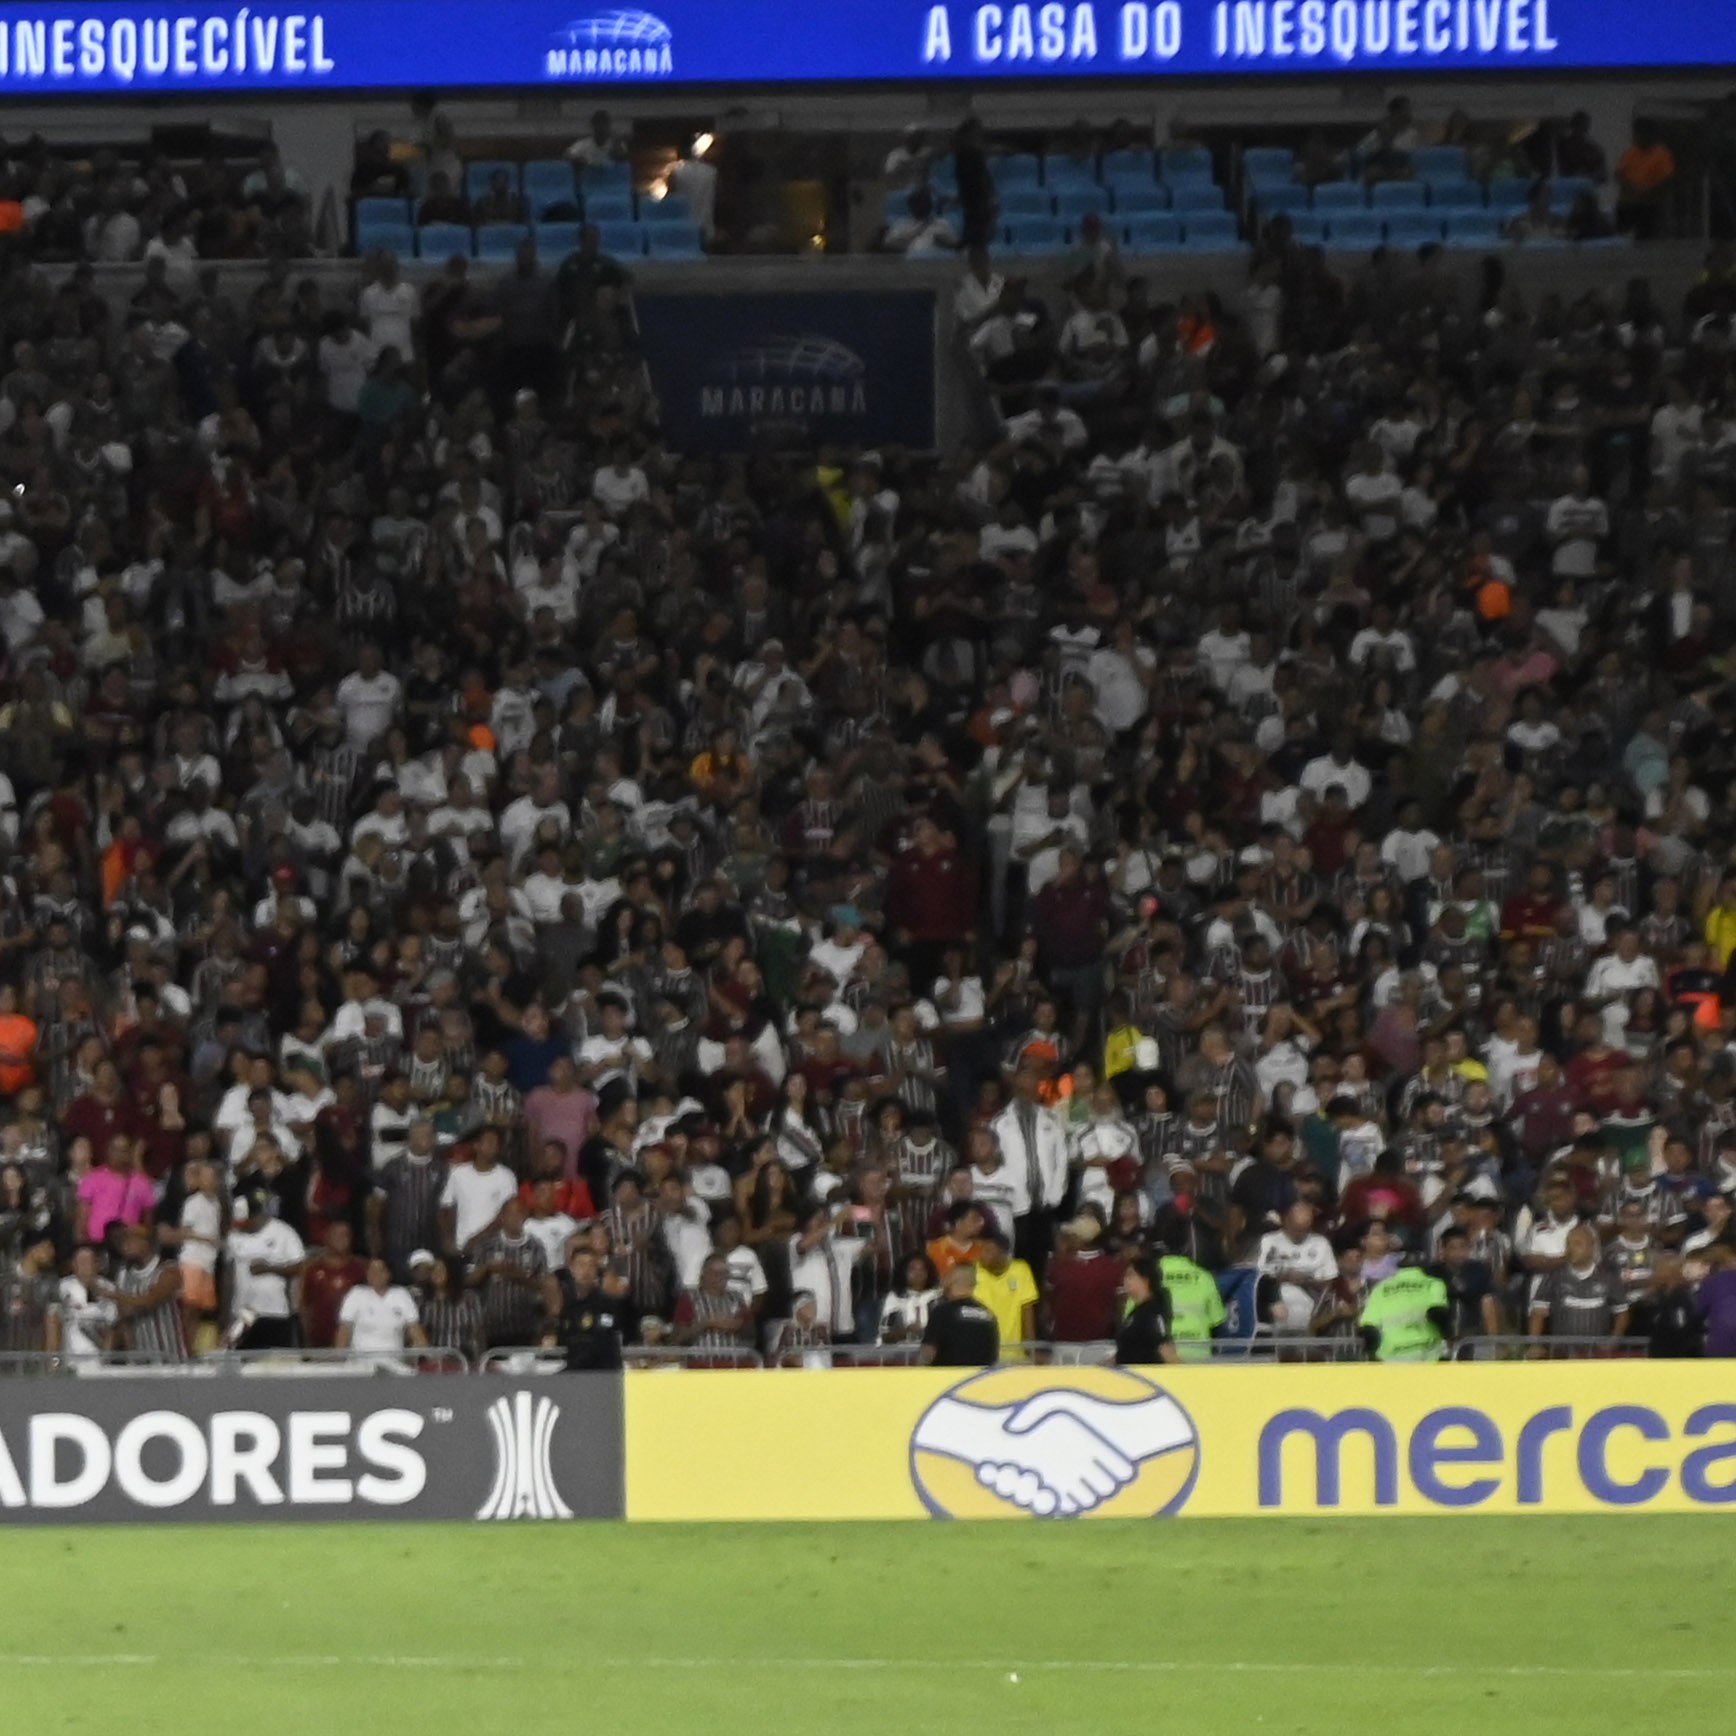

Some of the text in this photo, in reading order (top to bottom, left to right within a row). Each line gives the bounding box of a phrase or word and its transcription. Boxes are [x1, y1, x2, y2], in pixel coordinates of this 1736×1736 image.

[925, 7, 952, 62] A
[976, 4, 1098, 62] CASA
[1122, 2, 1182, 60] DO
